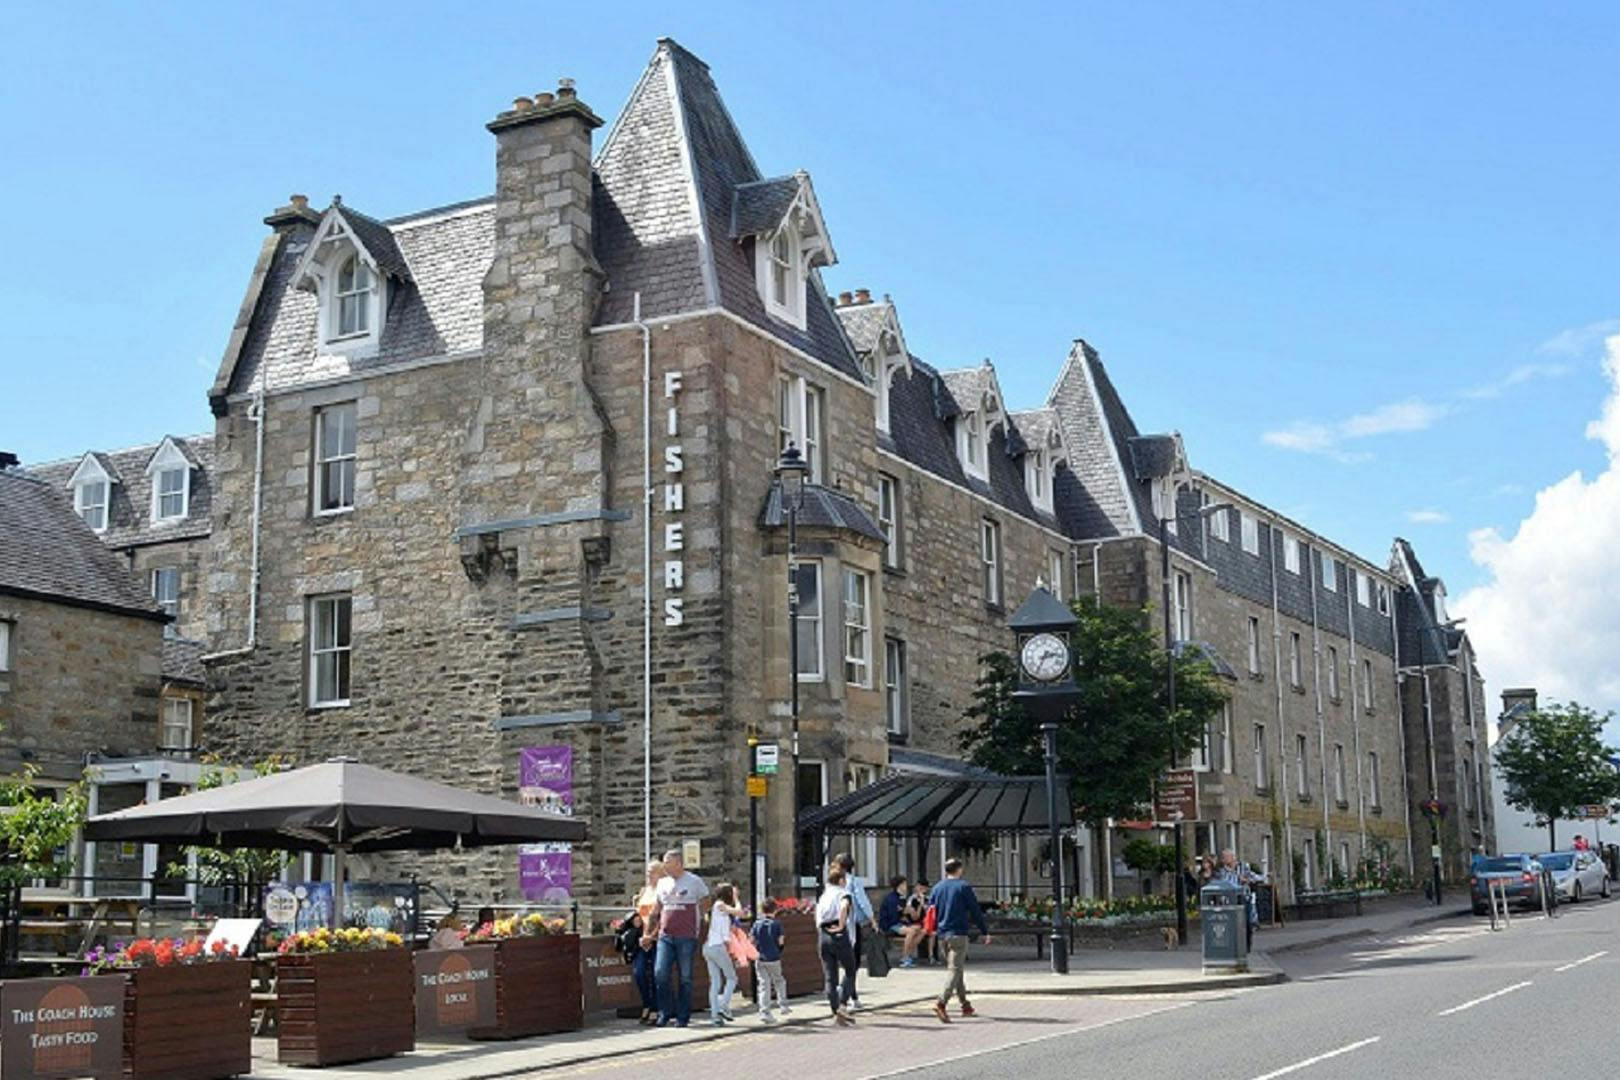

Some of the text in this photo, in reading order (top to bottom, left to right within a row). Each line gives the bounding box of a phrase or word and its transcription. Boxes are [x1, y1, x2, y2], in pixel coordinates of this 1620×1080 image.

[664, 371, 683, 626] FISHERS
[12, 1005, 116, 1024] THE COACH HOUSE
[31, 1031, 98, 1049] TASTY FOOD
